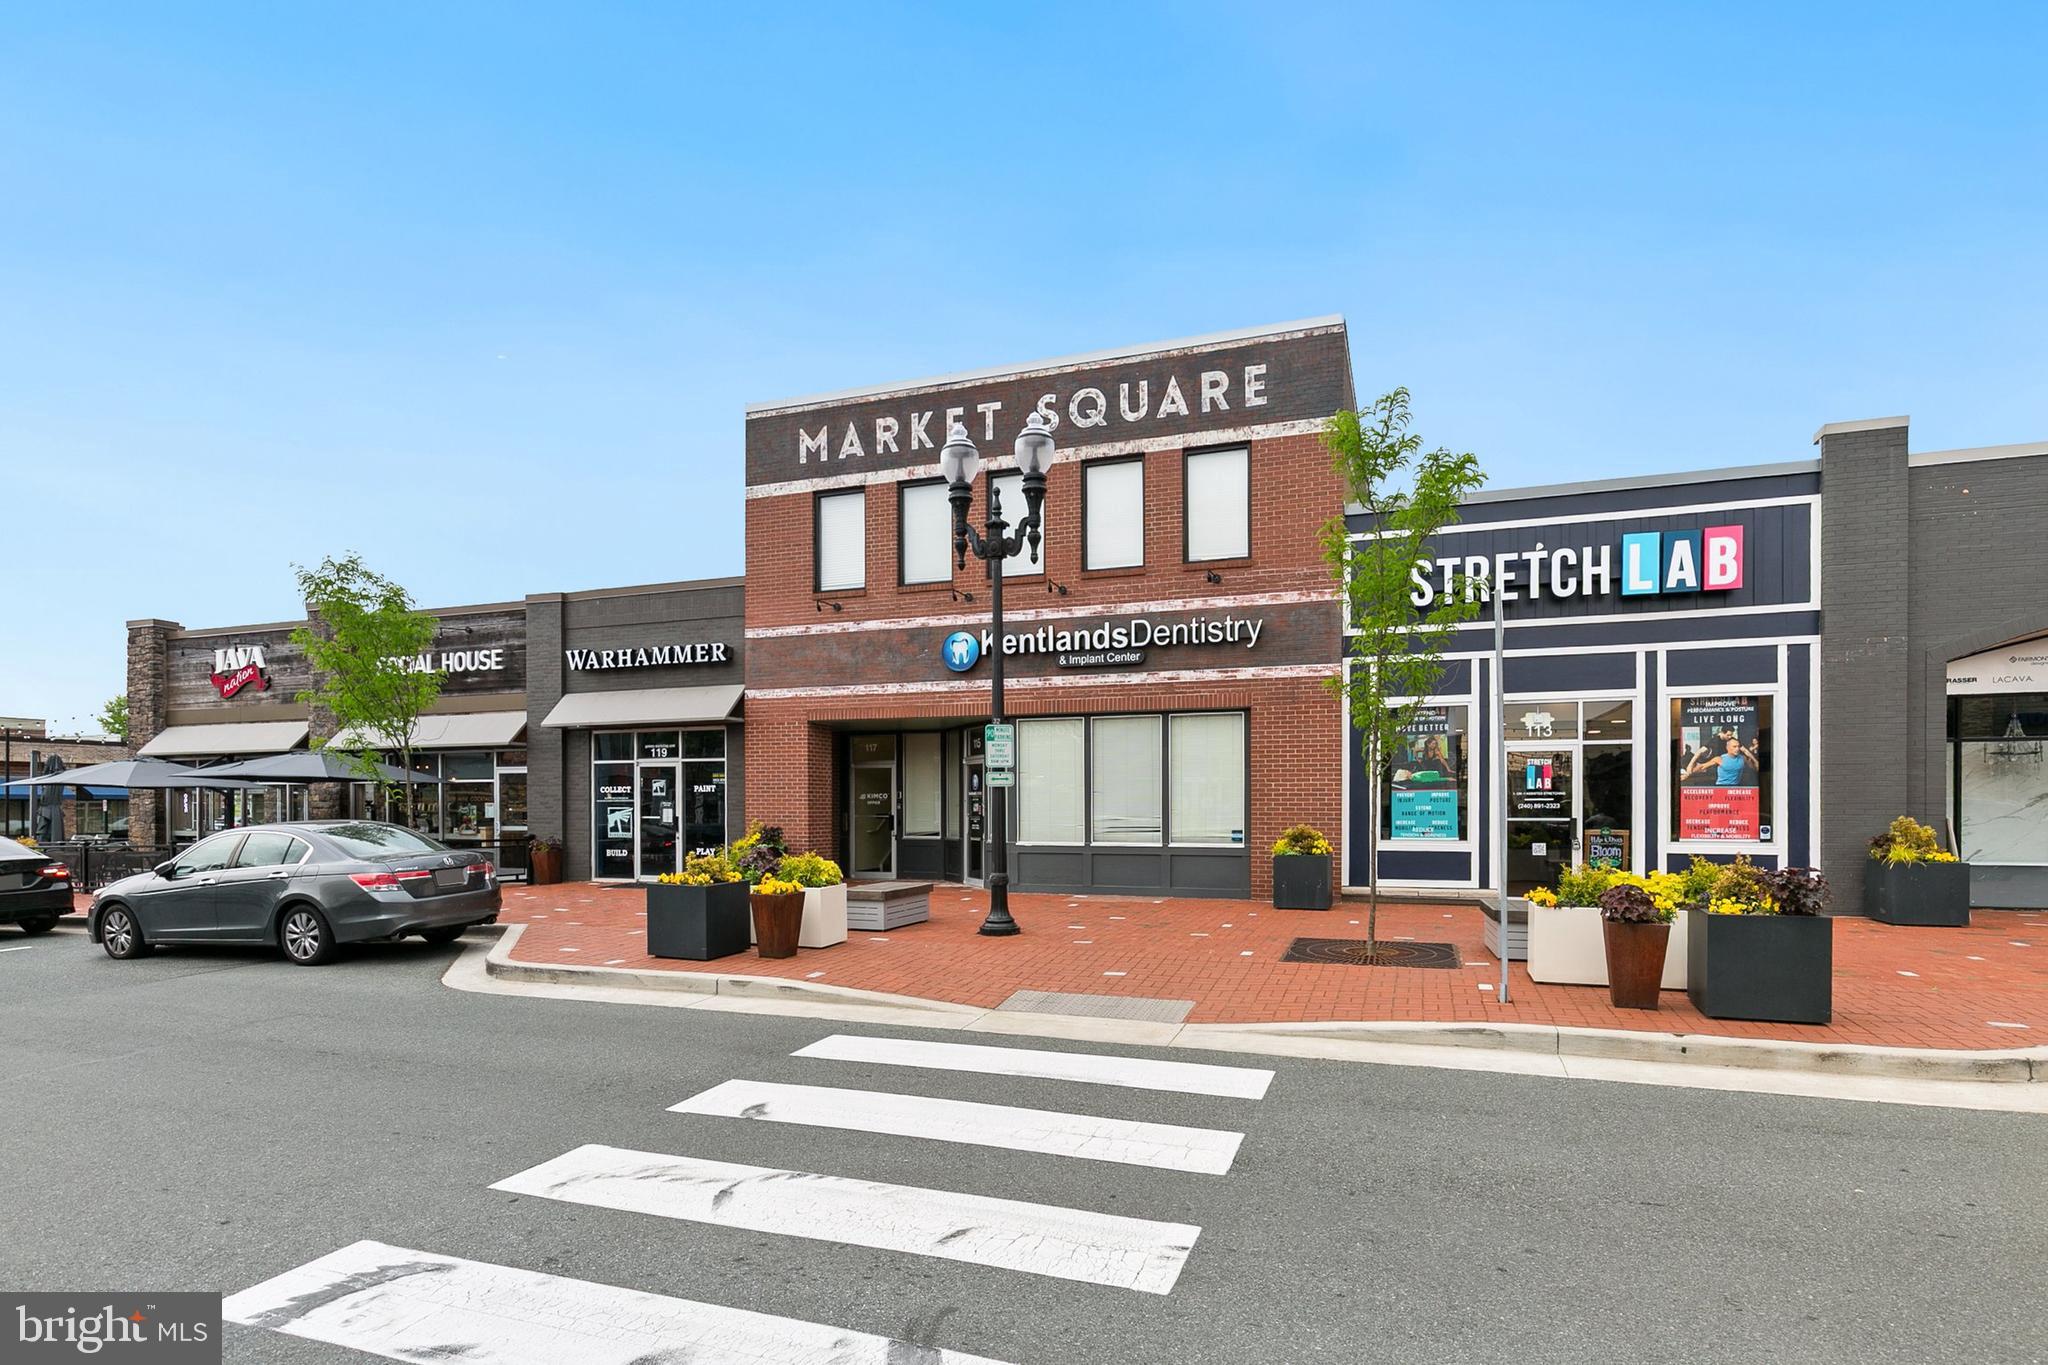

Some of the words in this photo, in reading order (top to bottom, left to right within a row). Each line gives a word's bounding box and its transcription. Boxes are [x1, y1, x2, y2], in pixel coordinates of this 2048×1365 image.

[799, 401, 1001, 464] MARKET
[1035, 363, 1267, 432] SQUARE
[1409, 543, 1611, 607] STRETCH
[1628, 537, 1738, 590] LAB
[213, 646, 266, 675] JAVA
[441, 649, 505, 673] HOUSE
[566, 642, 727, 671] WARHAMMER
[1059, 656, 1067, 665] &
[1069, 654, 1104, 668] Implant
[1106, 652, 1141, 664] Center
[223, 667, 255, 693] nation
[1992, 675, 2033, 684] LACAVA
[1694, 716, 1714, 724] LIVE
[1720, 715, 1745, 723] LONG
[1418, 723, 1450, 732] BETTER
[1526, 724, 1553, 737] 113
[651, 748, 668, 757] 119
[600, 786, 632, 794] COLLECT
[696, 847, 716, 856] PLAY
[1591, 845, 1622, 858] Bloom
